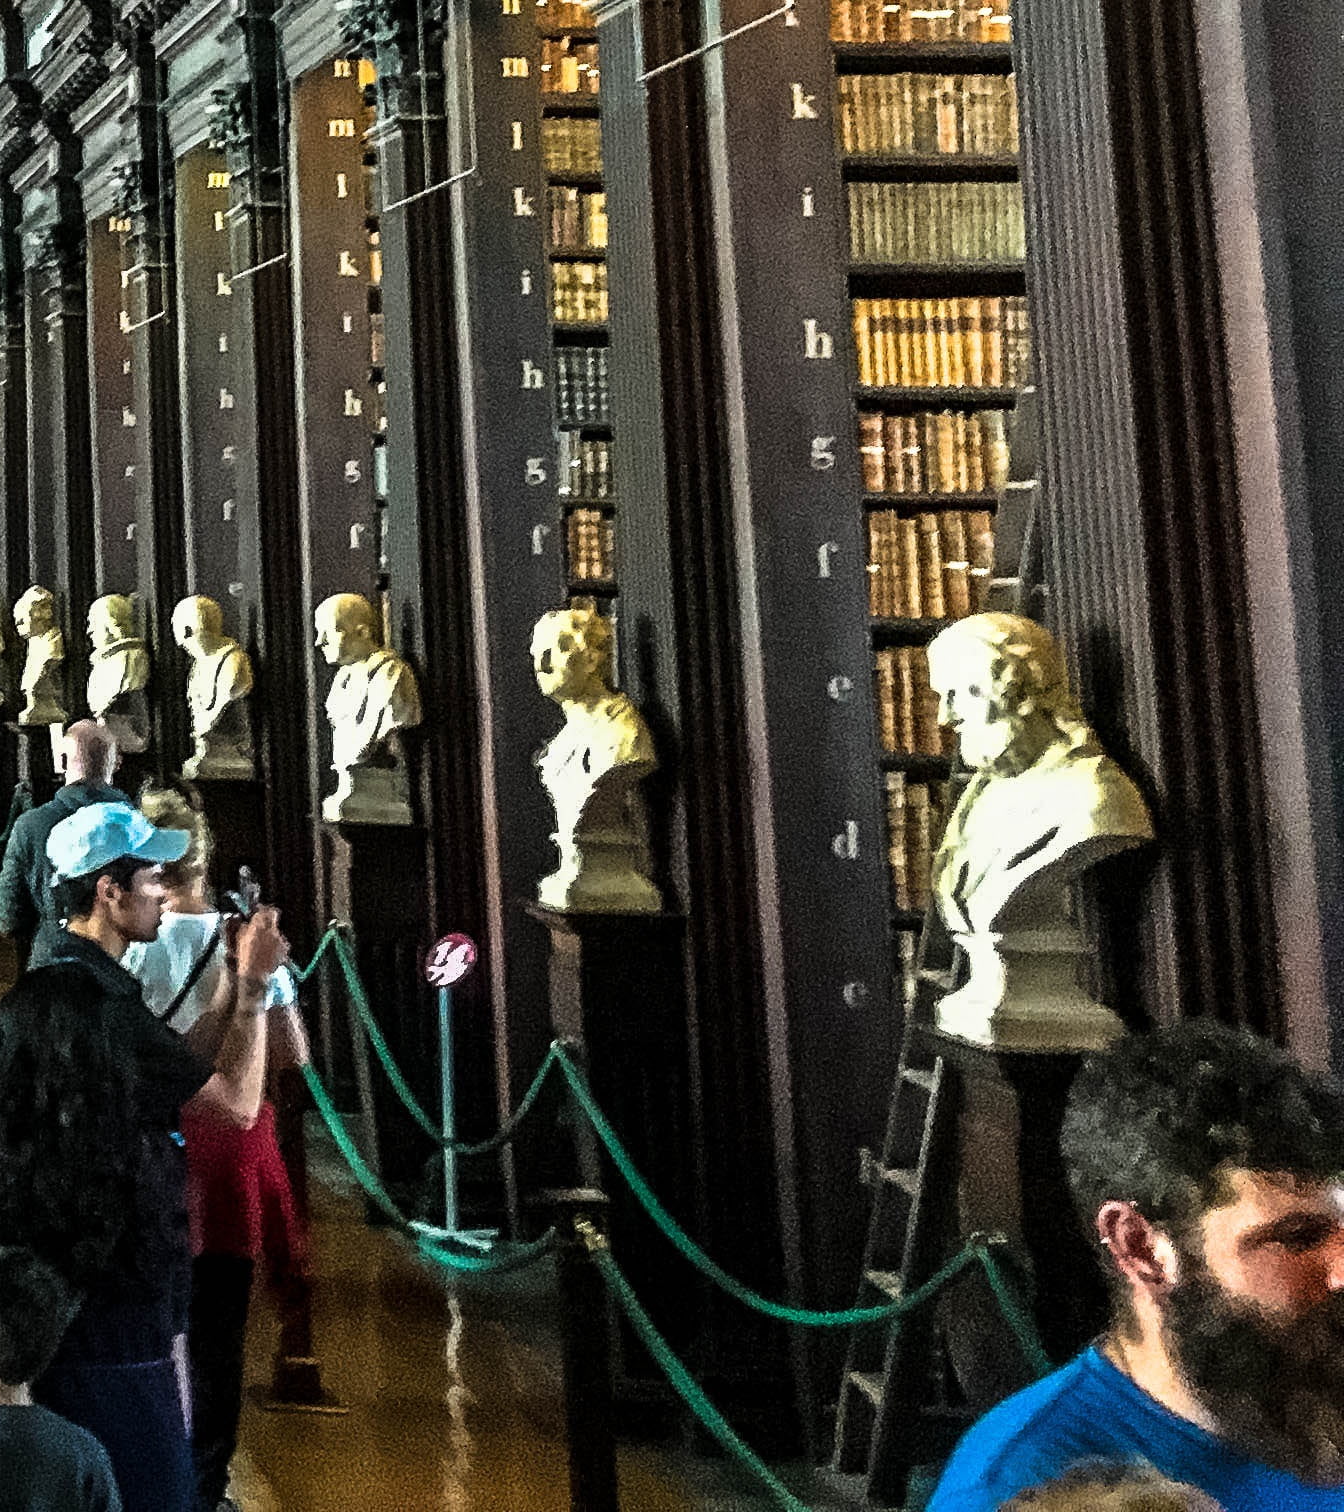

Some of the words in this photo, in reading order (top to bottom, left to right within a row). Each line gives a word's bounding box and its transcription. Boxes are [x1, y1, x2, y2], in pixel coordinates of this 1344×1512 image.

[501, 57, 529, 78] m
[791, 83, 817, 118] k
[511, 121, 523, 150] l
[513, 186, 535, 216] k
[802, 189, 814, 217] i
[521, 269, 532, 295] i
[803, 320, 833, 359] h
[521, 359, 544, 388] h
[812, 436, 836, 469] g
[525, 457, 546, 486] g
[531, 523, 550, 555] f
[818, 541, 838, 578] f
[832, 820, 859, 860] d
